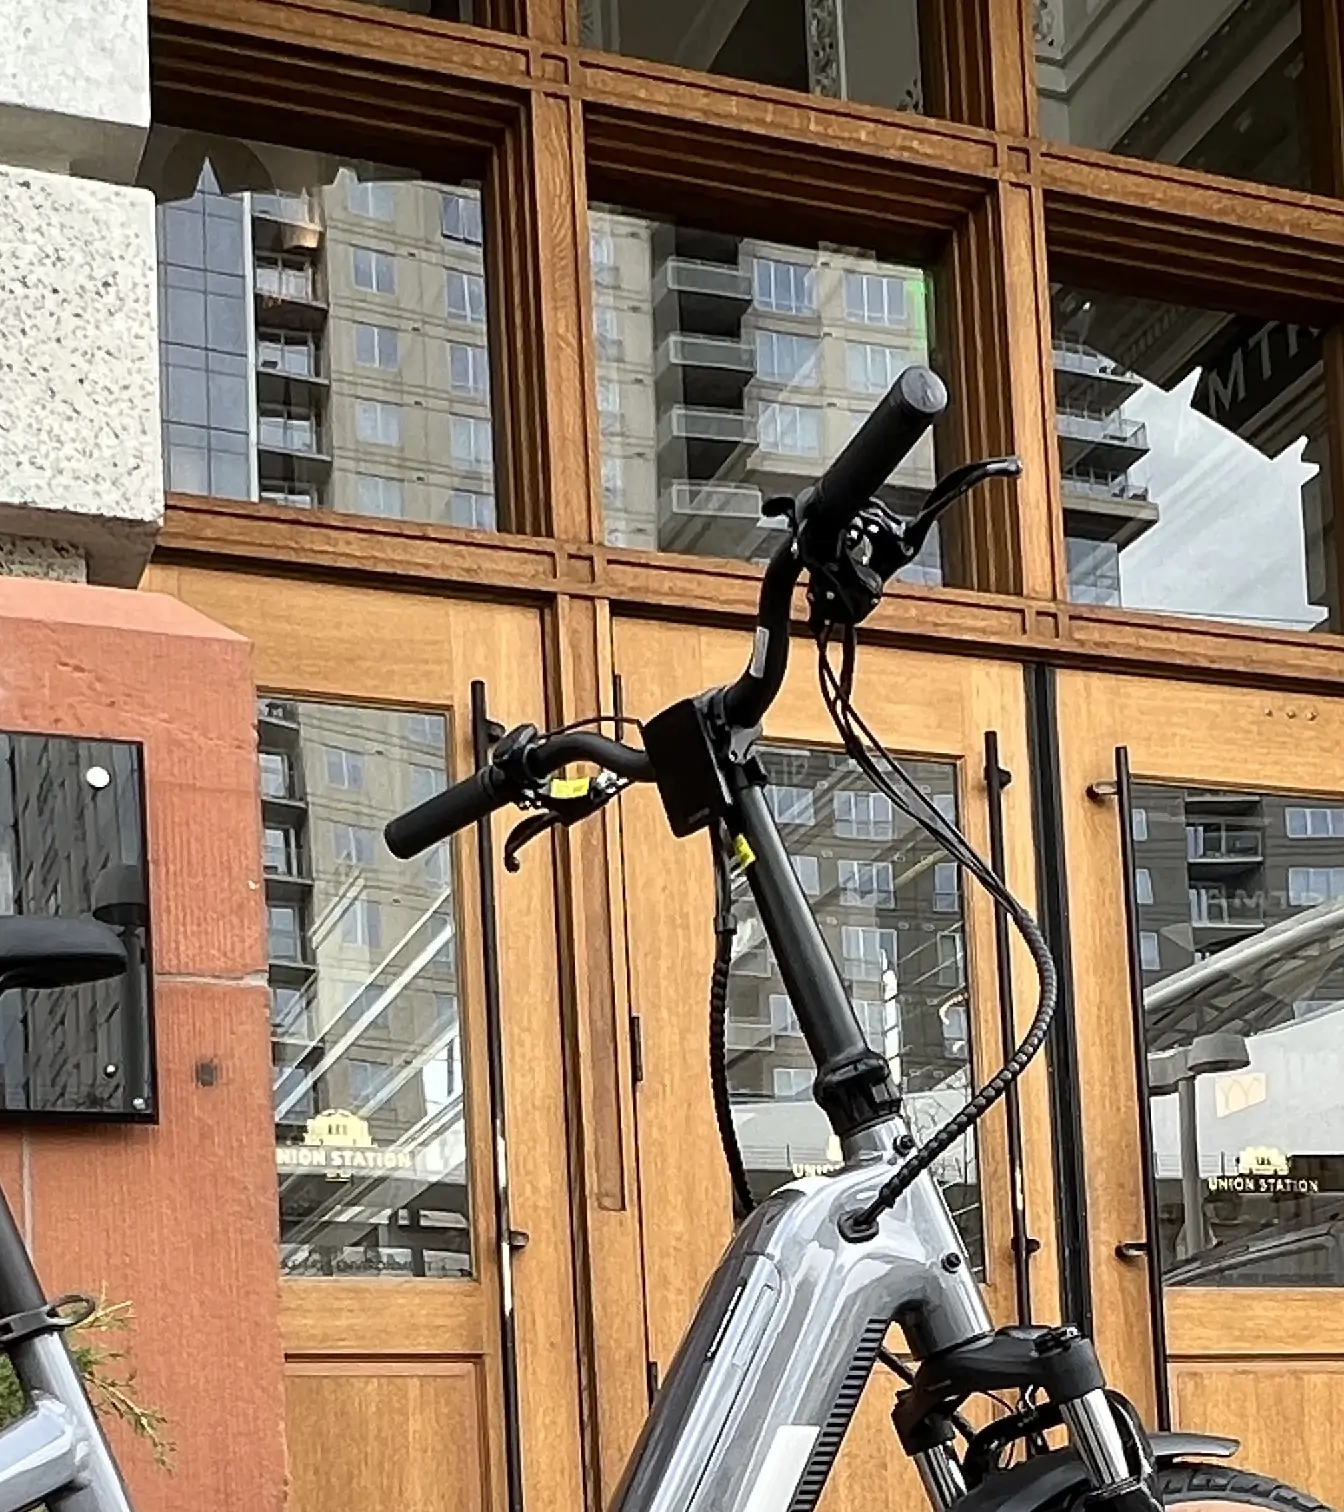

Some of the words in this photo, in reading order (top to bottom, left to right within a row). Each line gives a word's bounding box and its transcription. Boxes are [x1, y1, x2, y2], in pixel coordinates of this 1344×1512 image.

[276, 1147, 326, 1166] NION
[331, 1151, 413, 1168] STATION
[1208, 1177, 1254, 1191] UNION
[1259, 1178, 1318, 1192] STATION
